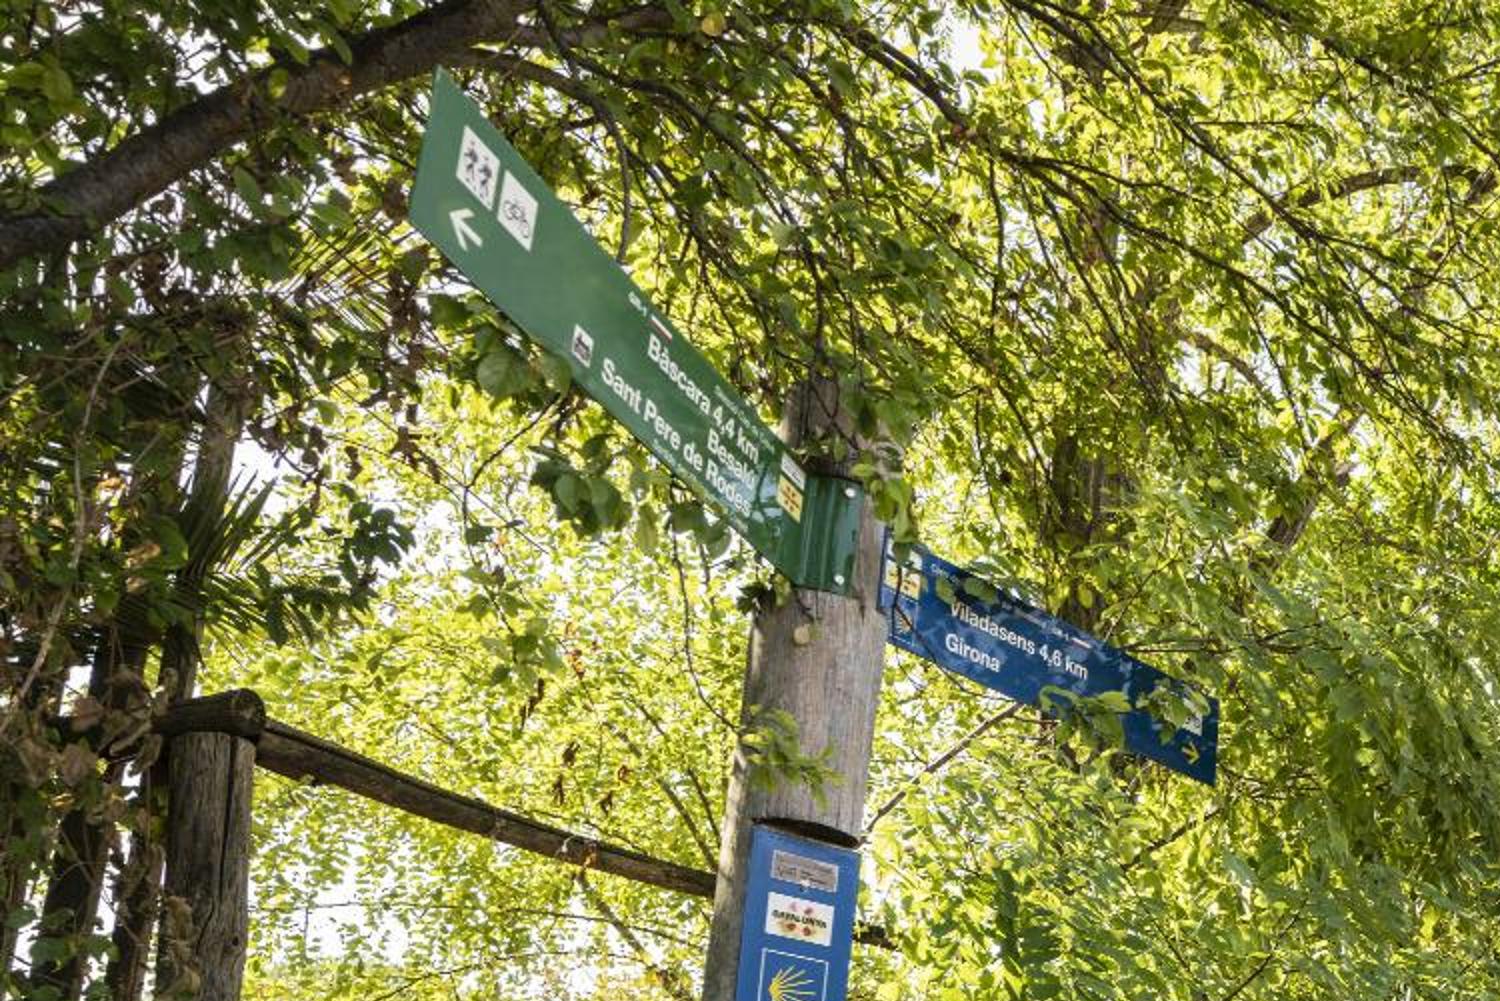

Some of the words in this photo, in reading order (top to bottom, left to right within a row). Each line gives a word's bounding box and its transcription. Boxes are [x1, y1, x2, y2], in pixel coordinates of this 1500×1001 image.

[601, 357, 642, 415] Sant
[643, 399, 681, 450] Pere
[683, 441, 704, 471] de
[705, 458, 752, 518] Rodes
[648, 333, 711, 416] Bàscara
[713, 406, 735, 439] 4,4
[736, 427, 759, 464] km
[944, 633, 1001, 673] Girona
[951, 601, 1036, 655] Viladasens
[1038, 643, 1063, 667] 4,6
[1065, 655, 1089, 680] km
